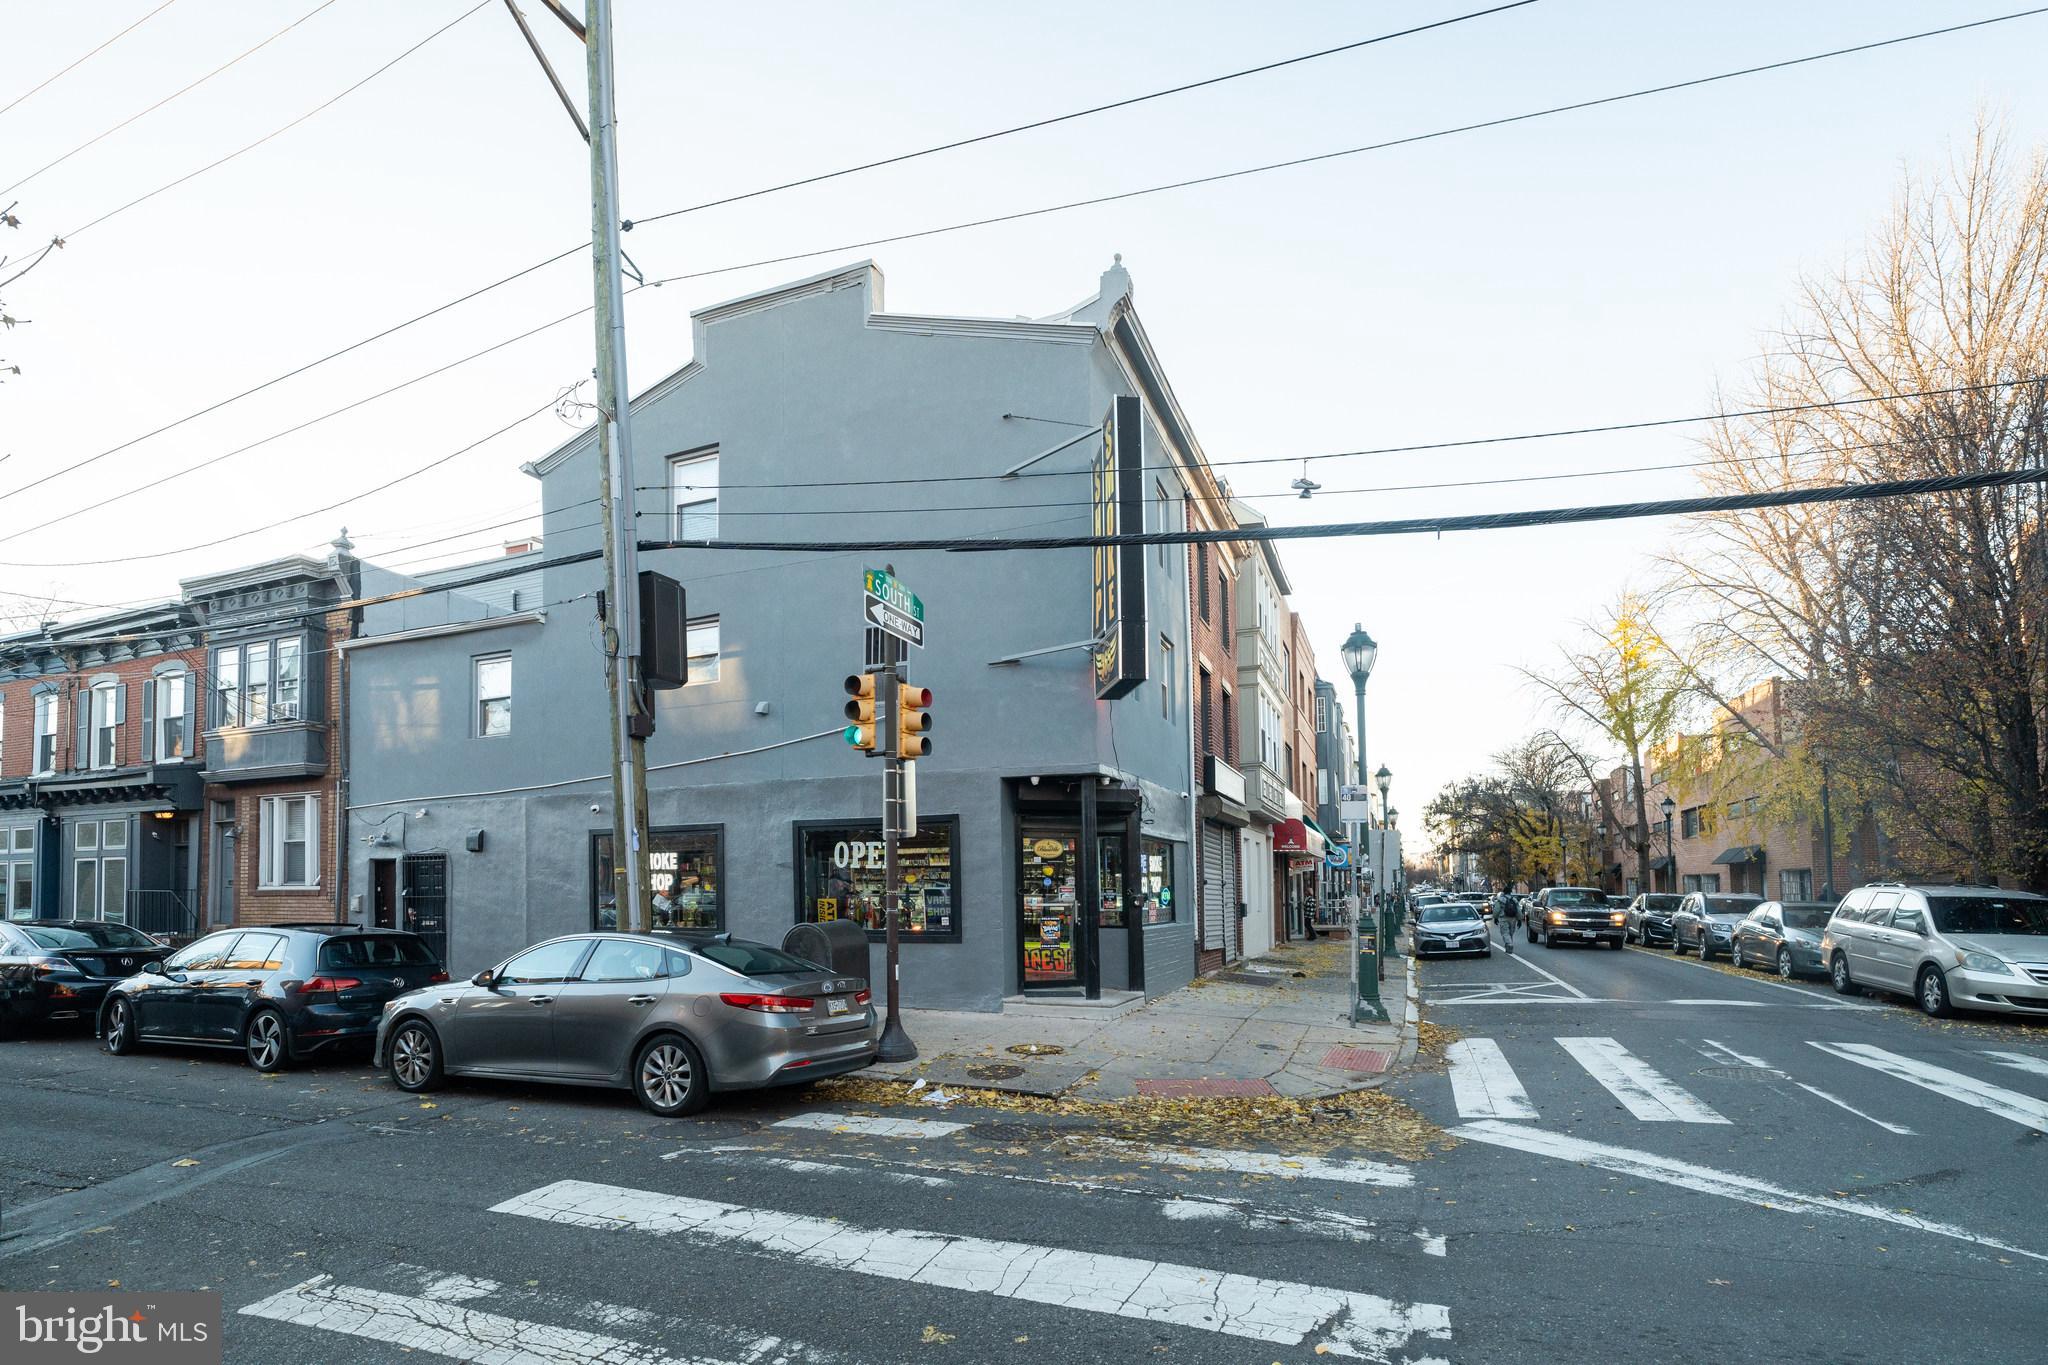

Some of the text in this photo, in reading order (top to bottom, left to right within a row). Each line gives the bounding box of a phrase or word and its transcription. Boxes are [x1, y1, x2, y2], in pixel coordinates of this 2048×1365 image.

[1104, 418, 1116, 621] SMOKE
[1094, 463, 1102, 630] SHOP
[875, 579, 920, 618] SOUTH ST
[883, 611, 921, 638] ONE WAY
[649, 852, 678, 870] OKE
[650, 873, 673, 891] HOP
[926, 895, 951, 904] VAPE
[826, 901, 835, 921] AT
[926, 907, 951, 916] SHOP
